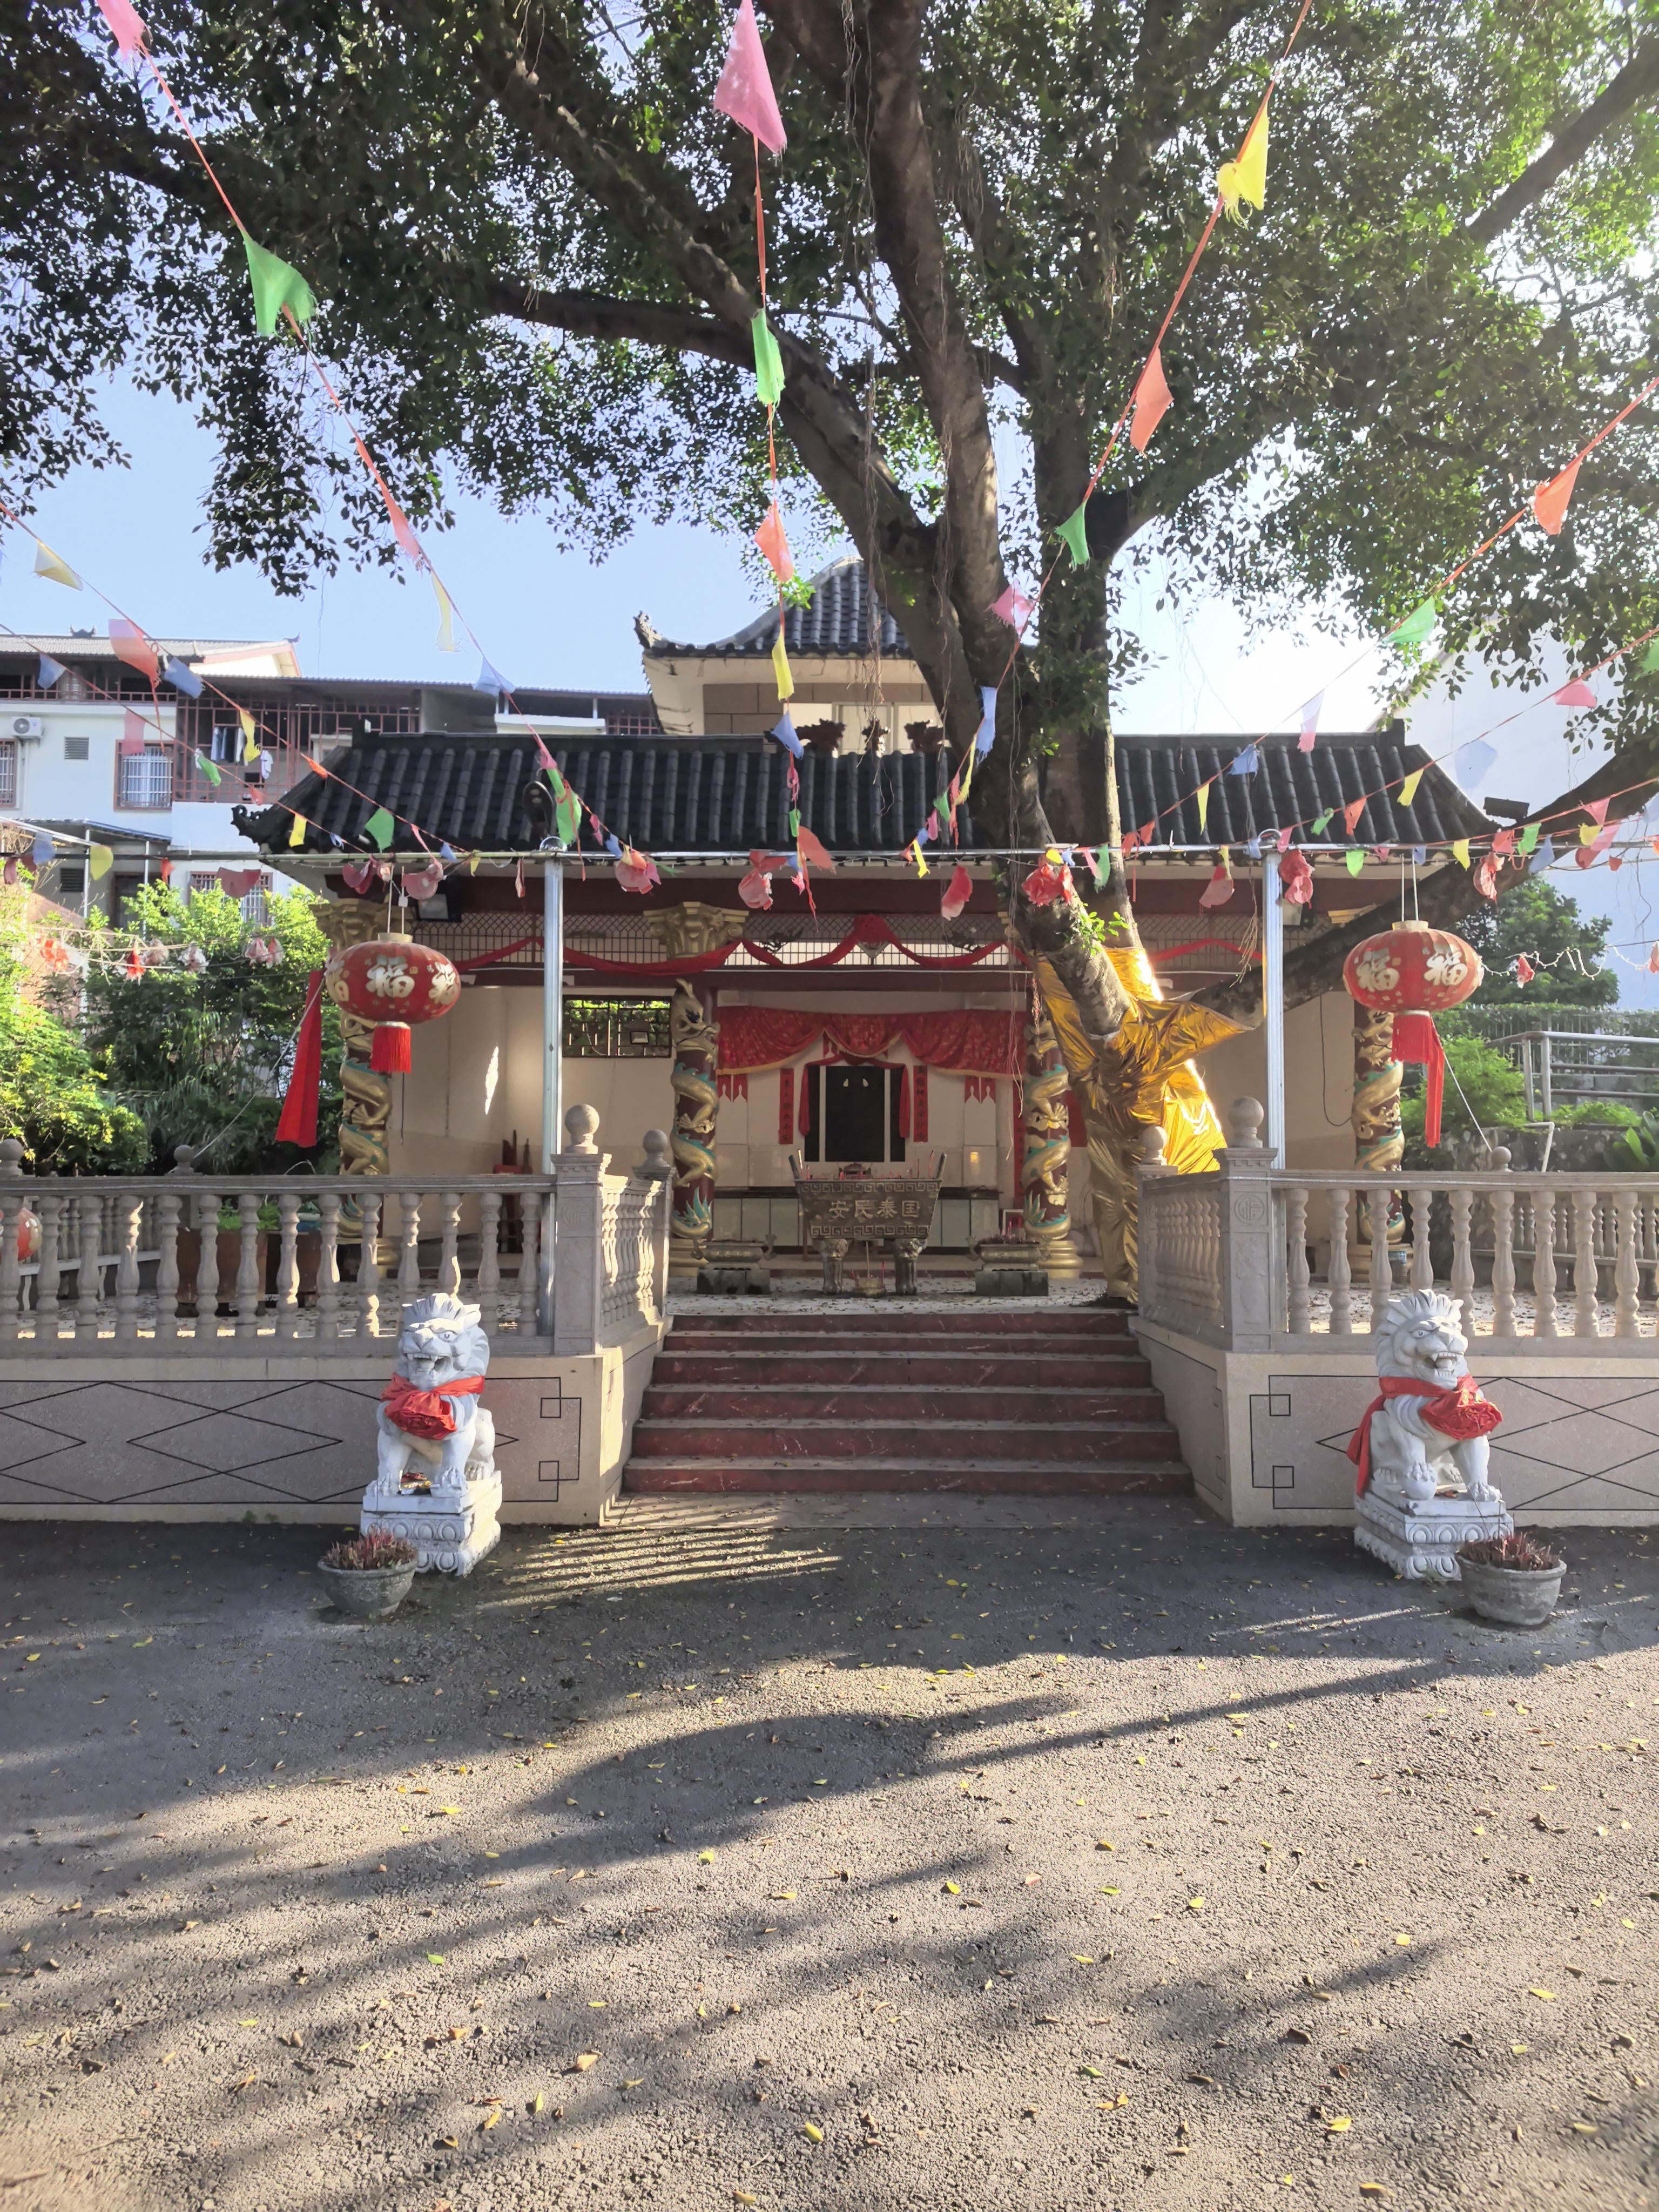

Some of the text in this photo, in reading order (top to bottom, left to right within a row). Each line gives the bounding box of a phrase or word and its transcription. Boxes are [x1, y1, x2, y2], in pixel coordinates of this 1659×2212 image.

[365, 954, 415, 998] 福
[1356, 948, 1399, 992] 福
[1424, 942, 1468, 986] 福
